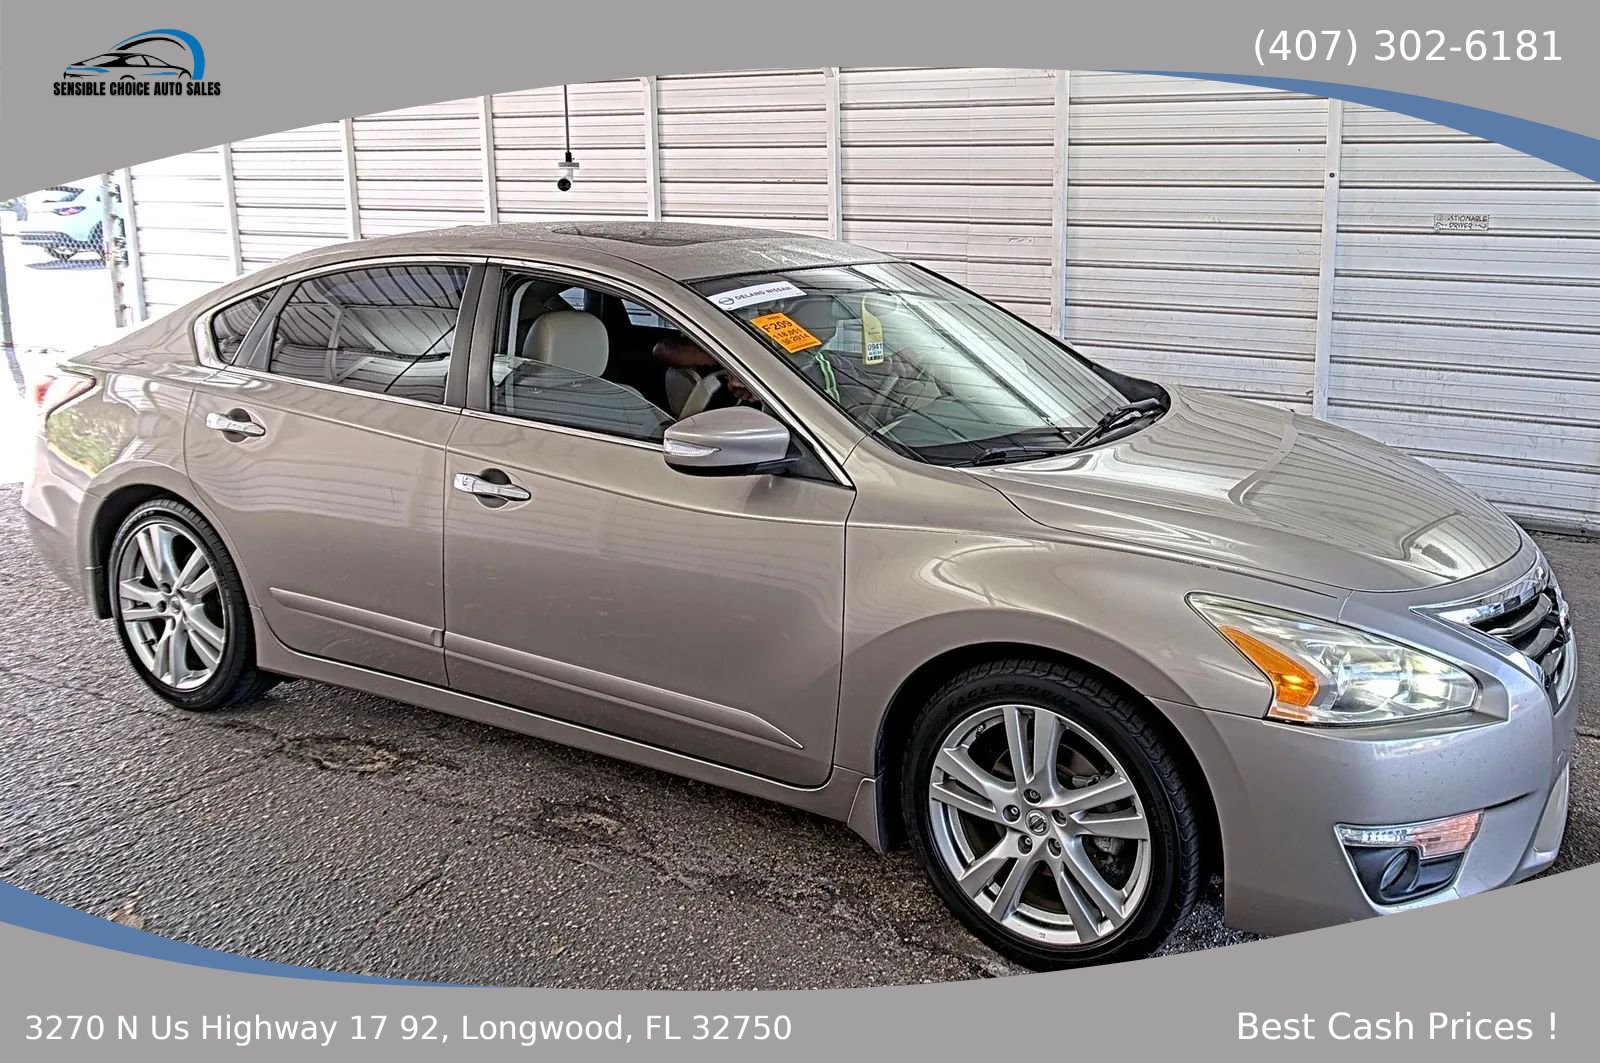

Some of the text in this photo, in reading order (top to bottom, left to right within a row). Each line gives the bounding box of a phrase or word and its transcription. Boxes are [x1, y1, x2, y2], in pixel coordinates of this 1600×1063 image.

[735, 286, 793, 300] DELAND NISSAN
[762, 320, 793, 332] F209
